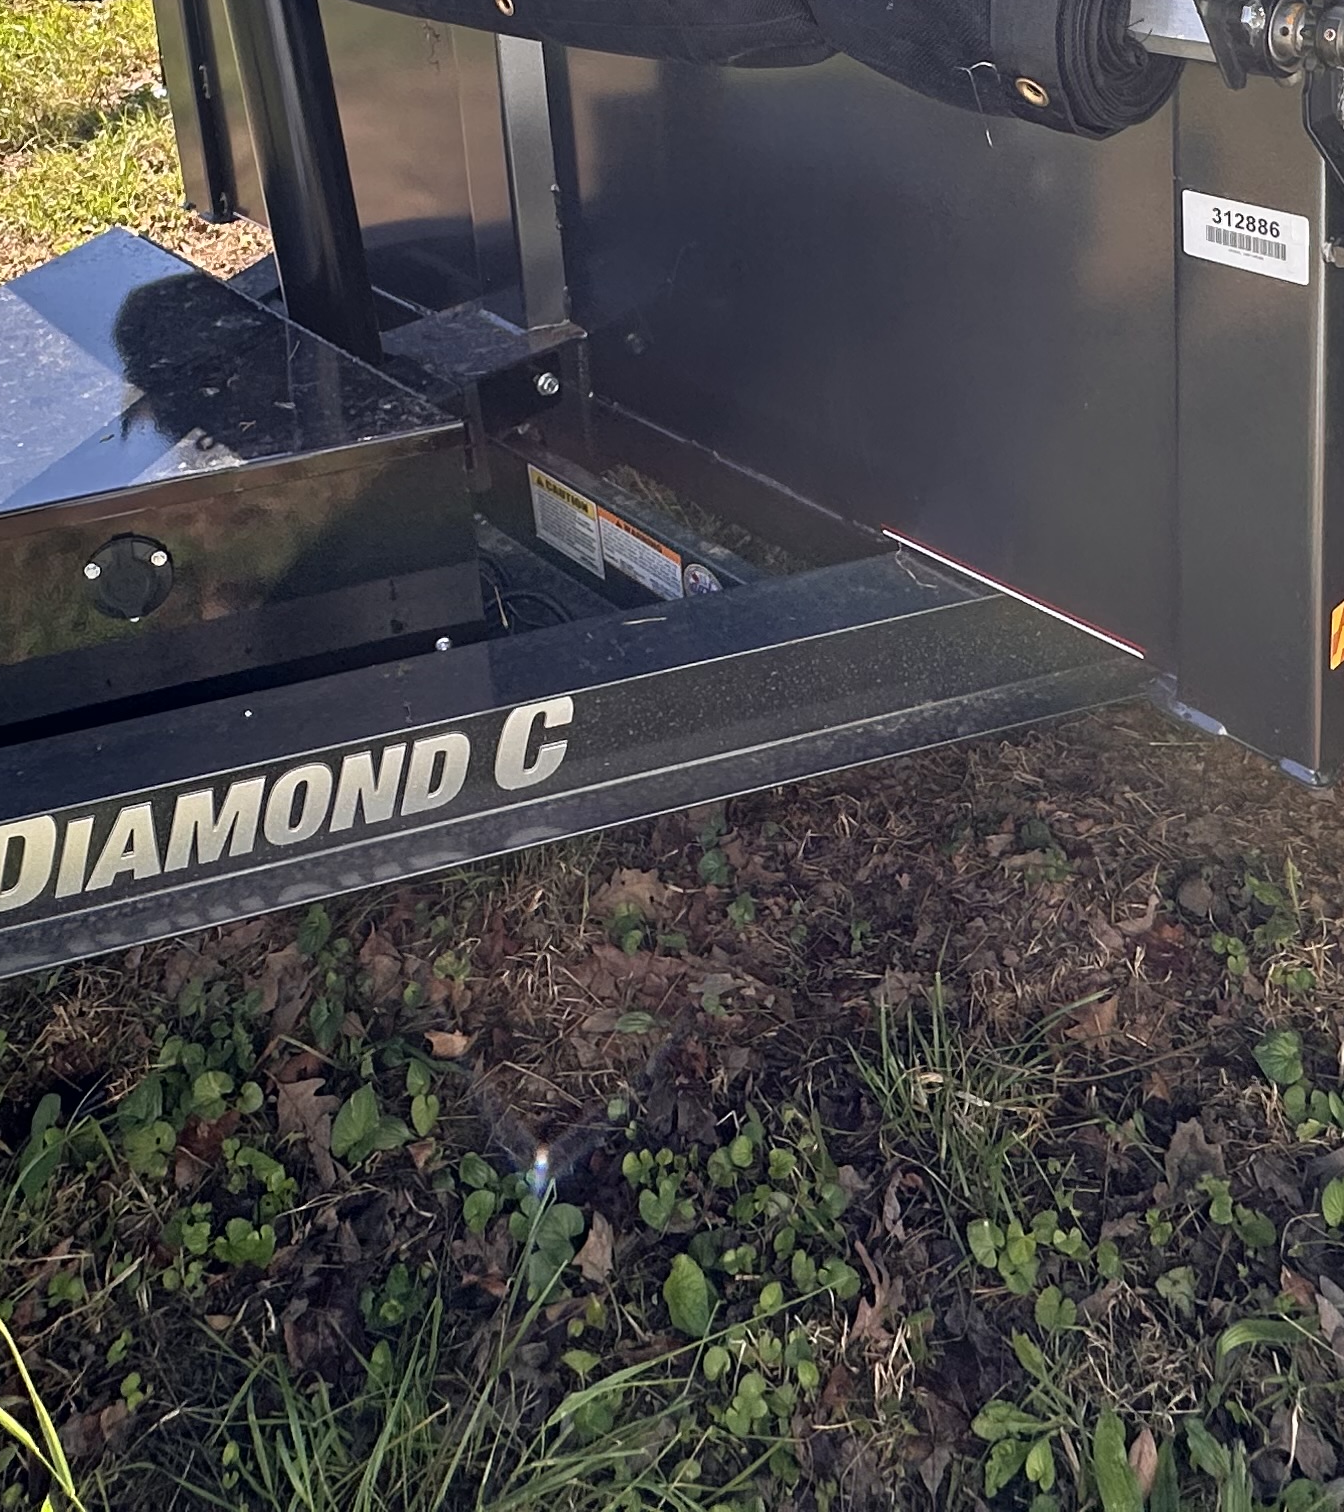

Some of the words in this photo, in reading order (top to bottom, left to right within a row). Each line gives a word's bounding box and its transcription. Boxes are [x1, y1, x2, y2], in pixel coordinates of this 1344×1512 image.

[1212, 207, 1280, 239] 312886
[545, 479, 589, 514] CAUTION
[494, 695, 574, 790] C
